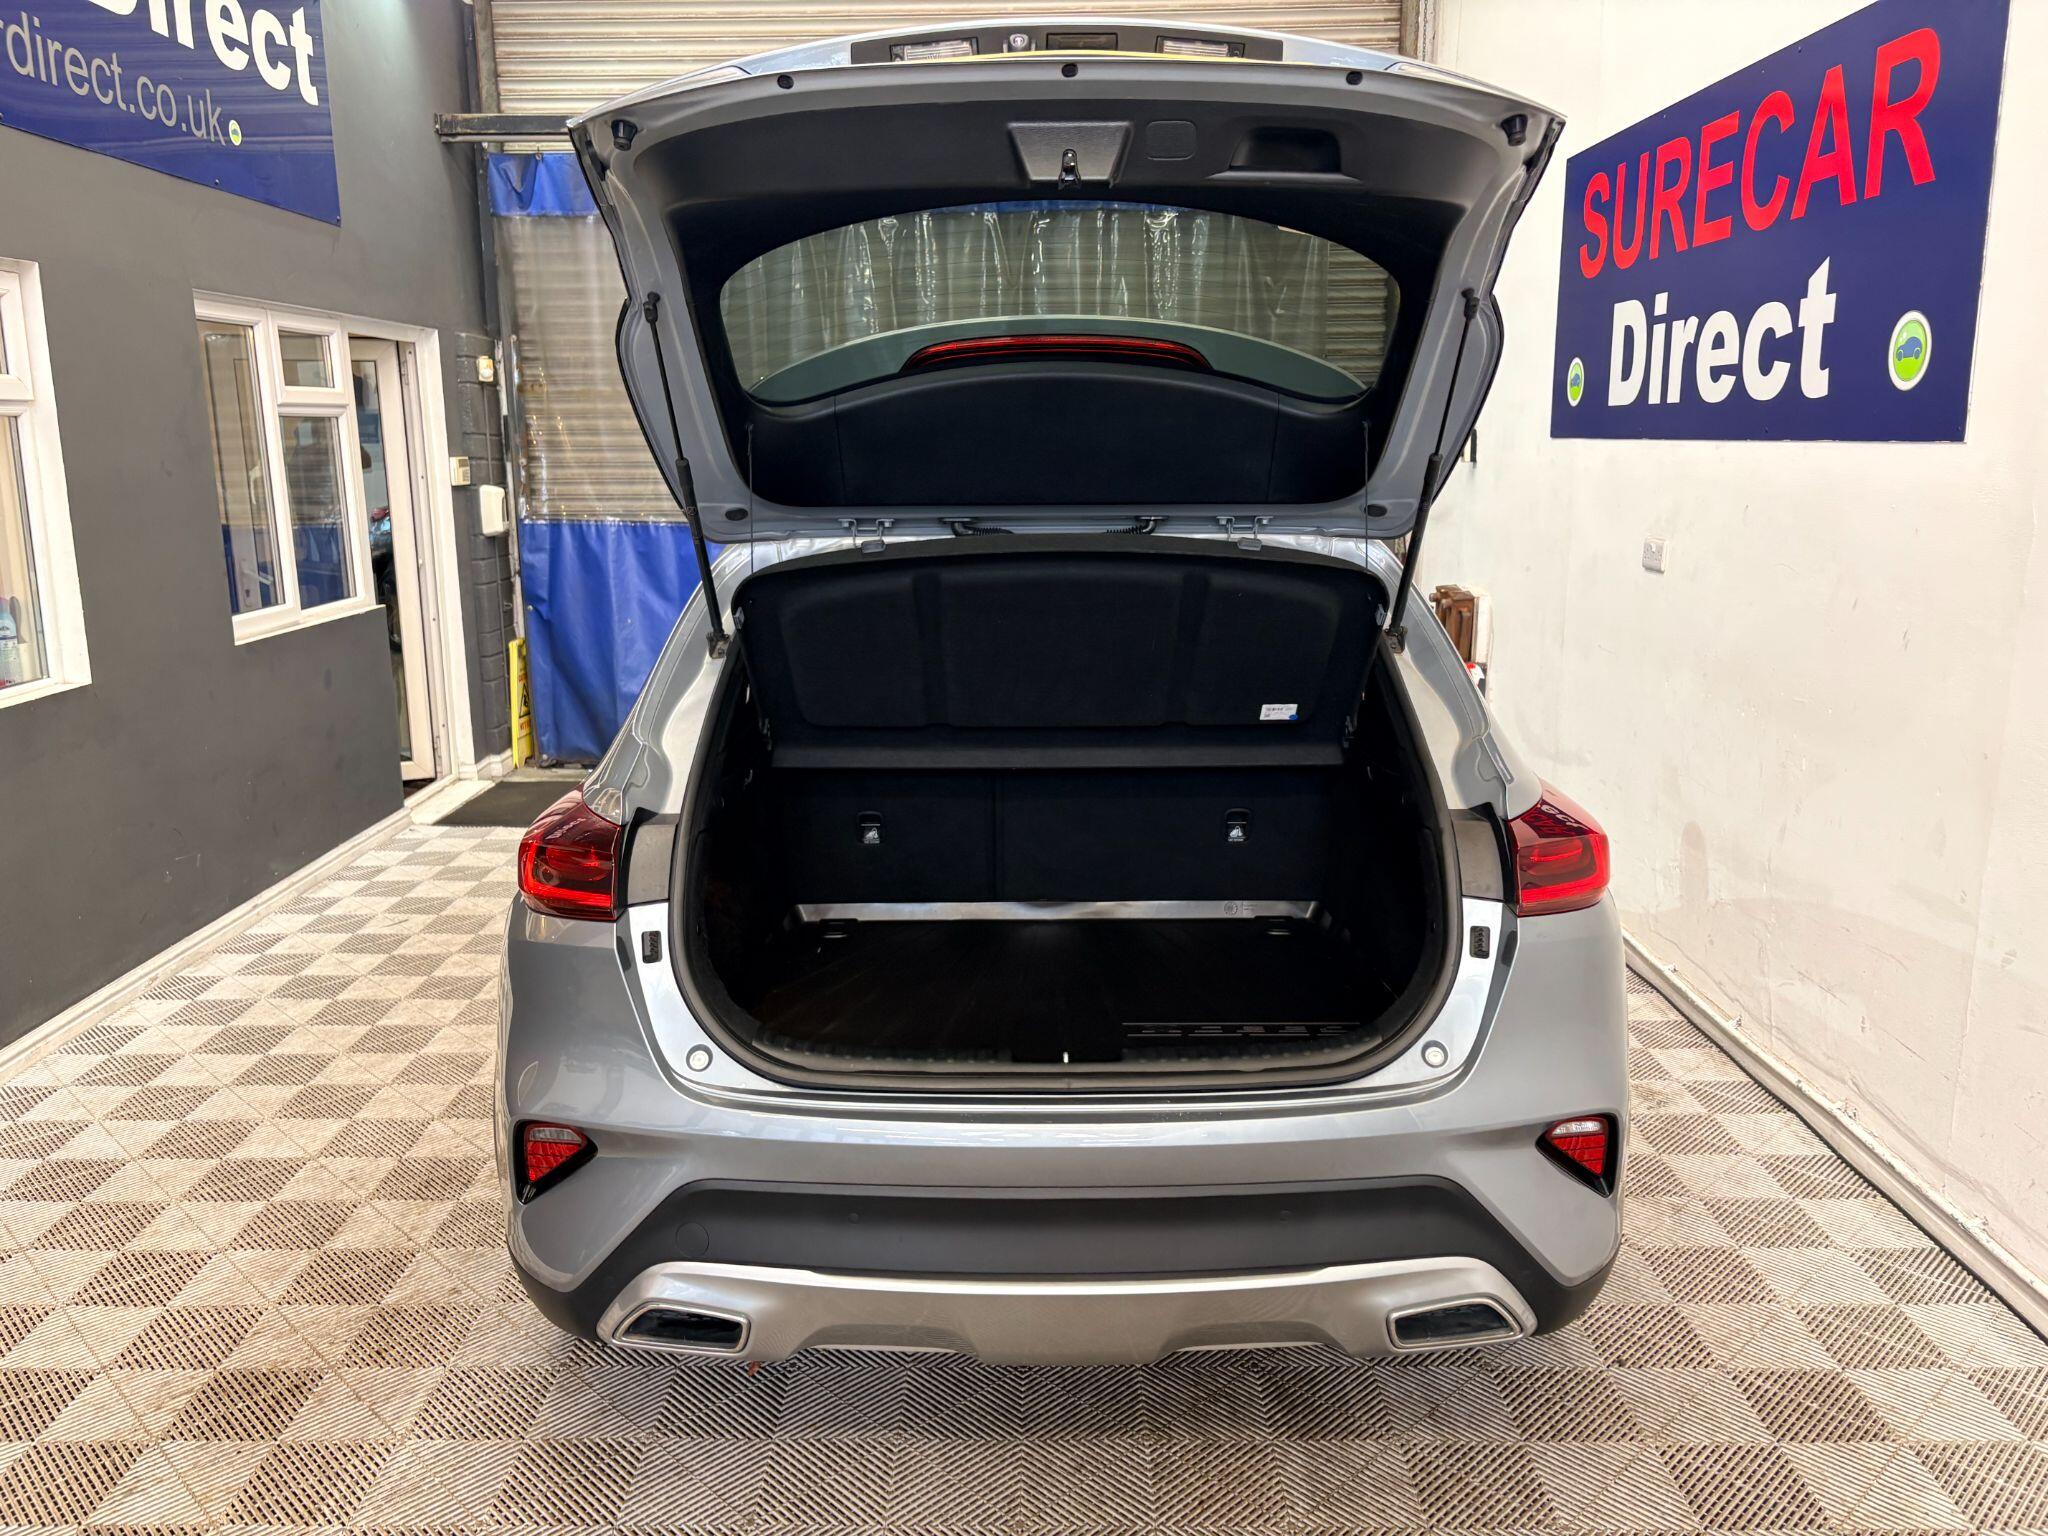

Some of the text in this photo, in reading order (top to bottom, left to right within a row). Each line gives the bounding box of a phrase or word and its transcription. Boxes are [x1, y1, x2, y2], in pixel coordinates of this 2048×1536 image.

[0, 11, 226, 146] direct.co.uk
[1579, 27, 1941, 279] SURECAR
[1607, 256, 1837, 407] Direct
